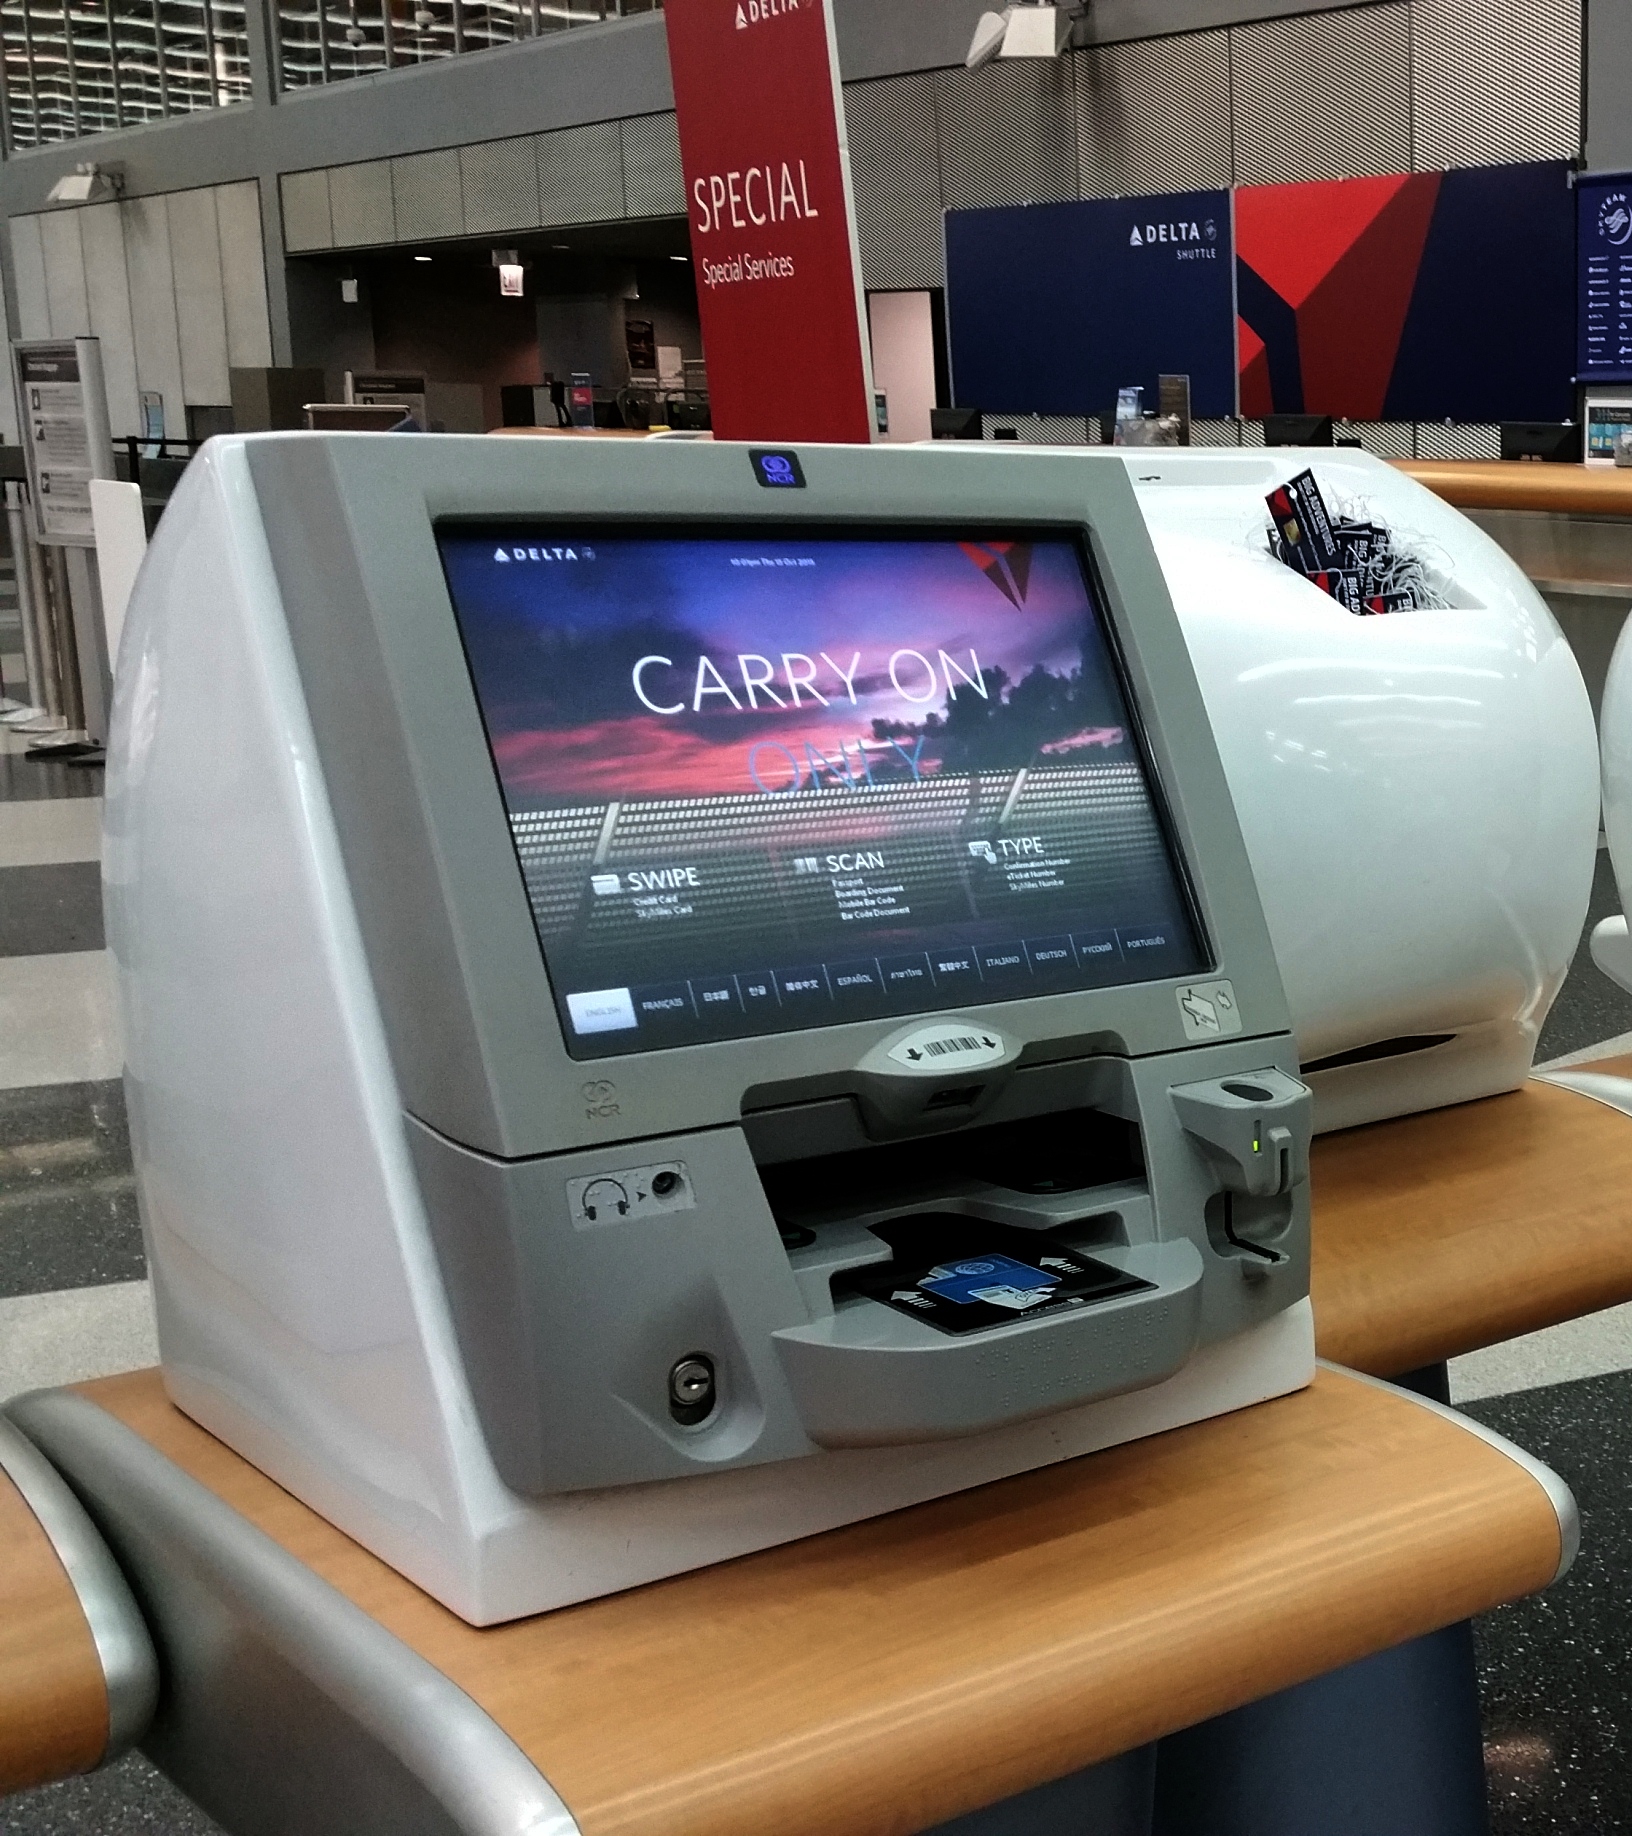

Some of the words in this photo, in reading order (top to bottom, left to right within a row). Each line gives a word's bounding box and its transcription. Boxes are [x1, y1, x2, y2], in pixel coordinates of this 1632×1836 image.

[693, 159, 819, 233] SPECIAL
[1146, 222, 1201, 243] DELTA
[1176, 248, 1217, 260] SHUTTLE
[702, 253, 743, 290] Special
[744, 251, 795, 281] Services
[767, 473, 796, 484] NCR
[1302, 476, 1315, 495] BIG
[1310, 496, 1336, 556] ADVENTURES
[513, 547, 578, 561] DELTA
[1359, 540, 1368, 559] BIG
[1347, 576, 1358, 595] BIG
[632, 651, 860, 714] CARRY
[888, 649, 989, 704] ON
[997, 837, 1044, 856] TYPE
[826, 851, 885, 873] SCAN
[1003, 861, 1045, 870] Confirmation
[1045, 858, 1071, 866] Number
[627, 867, 700, 891] SWIPE
[1031, 870, 1056, 878] Number
[1038, 880, 1065, 888] Number
[835, 889, 867, 898] Boarding
[867, 885, 904, 895] Document
[659, 894, 679, 904] Card
[876, 896, 896, 904] Code
[673, 905, 693, 915] Card
[854, 910, 873, 919] Code
[873, 906, 910, 917] Document
[1127, 936, 1165, 948] PORTUGUÊS
[985, 956, 1020, 967] ITALIANO
[1035, 950, 1068, 961] DEUTSCH
[837, 974, 873, 986] ESPAÑOL
[642, 997, 684, 1011] FRANÇAIS
[585, 1007, 621, 1017] ENGLISH
